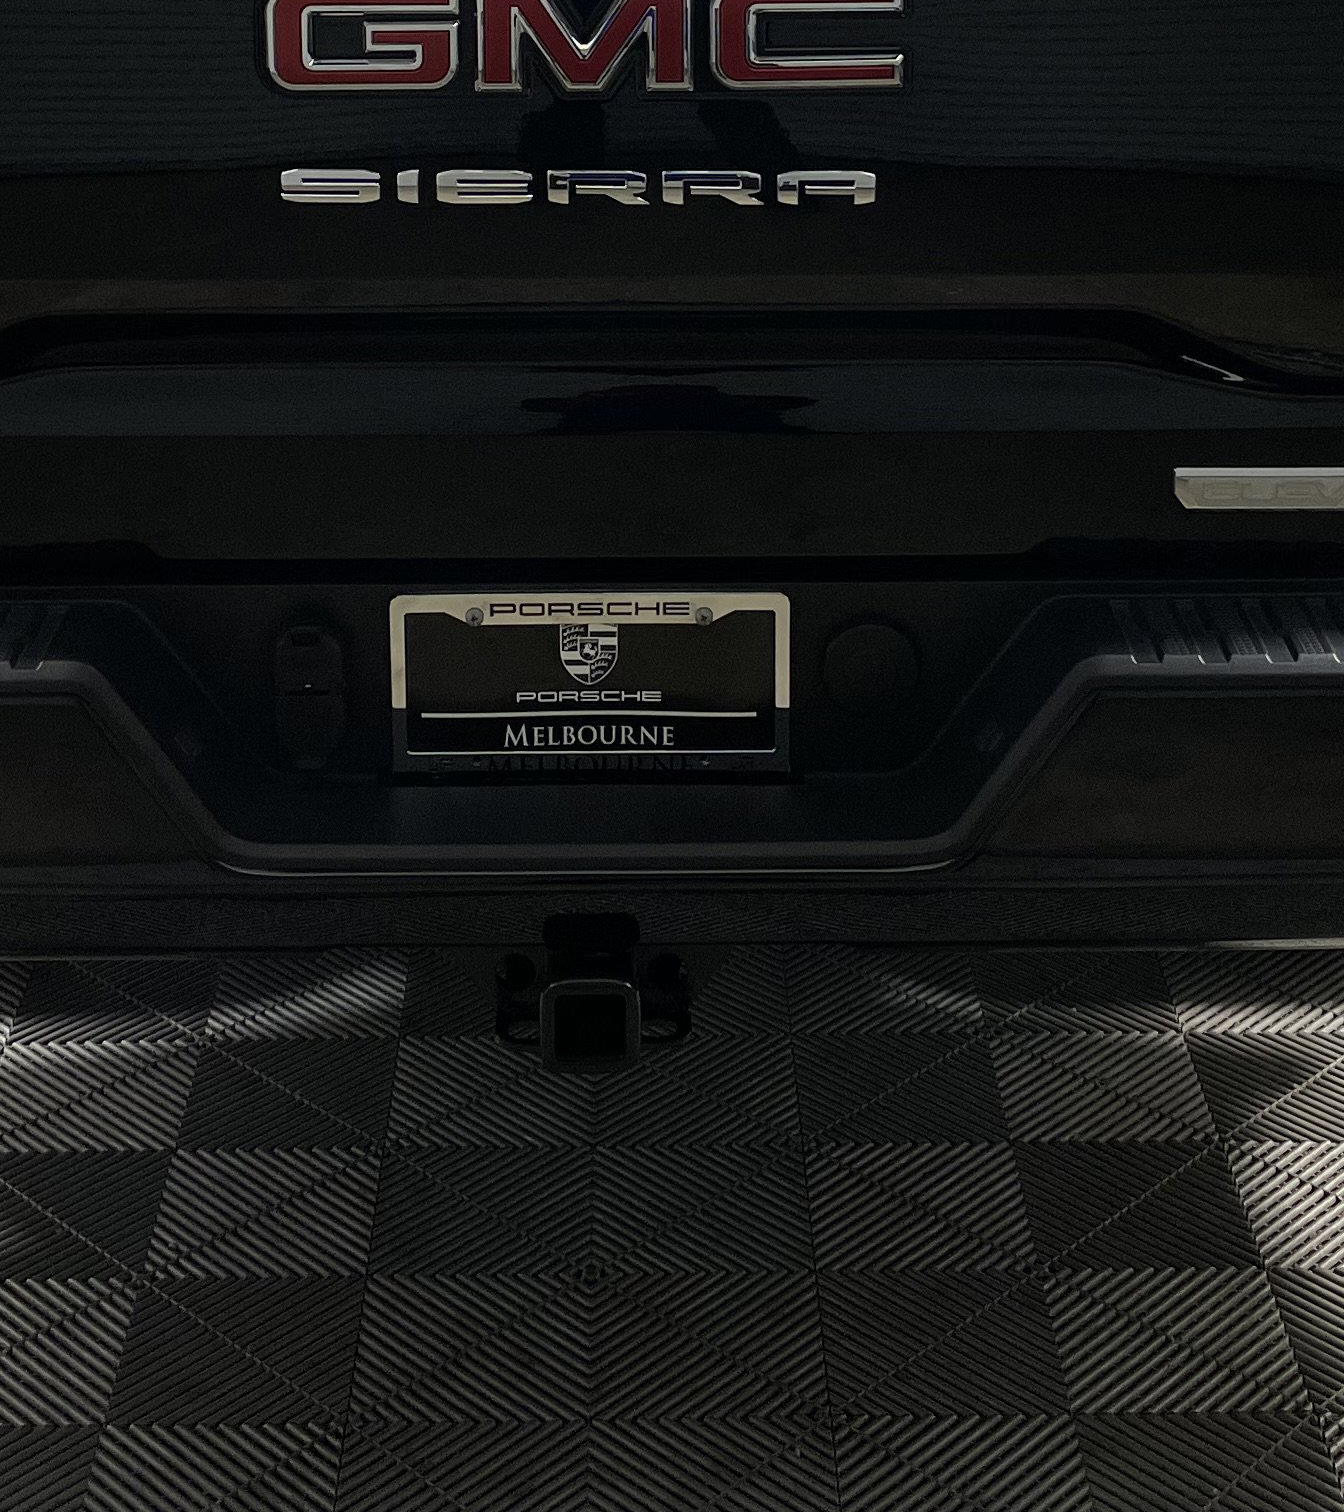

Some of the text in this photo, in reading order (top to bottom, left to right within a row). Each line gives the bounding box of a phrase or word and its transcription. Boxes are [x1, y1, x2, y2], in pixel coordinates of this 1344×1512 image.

[280, 169, 876, 205] SIERRA
[489, 602, 690, 617] PORSCHE
[516, 690, 662, 703] PORSCHE
[504, 724, 674, 748] MELBOURNE
